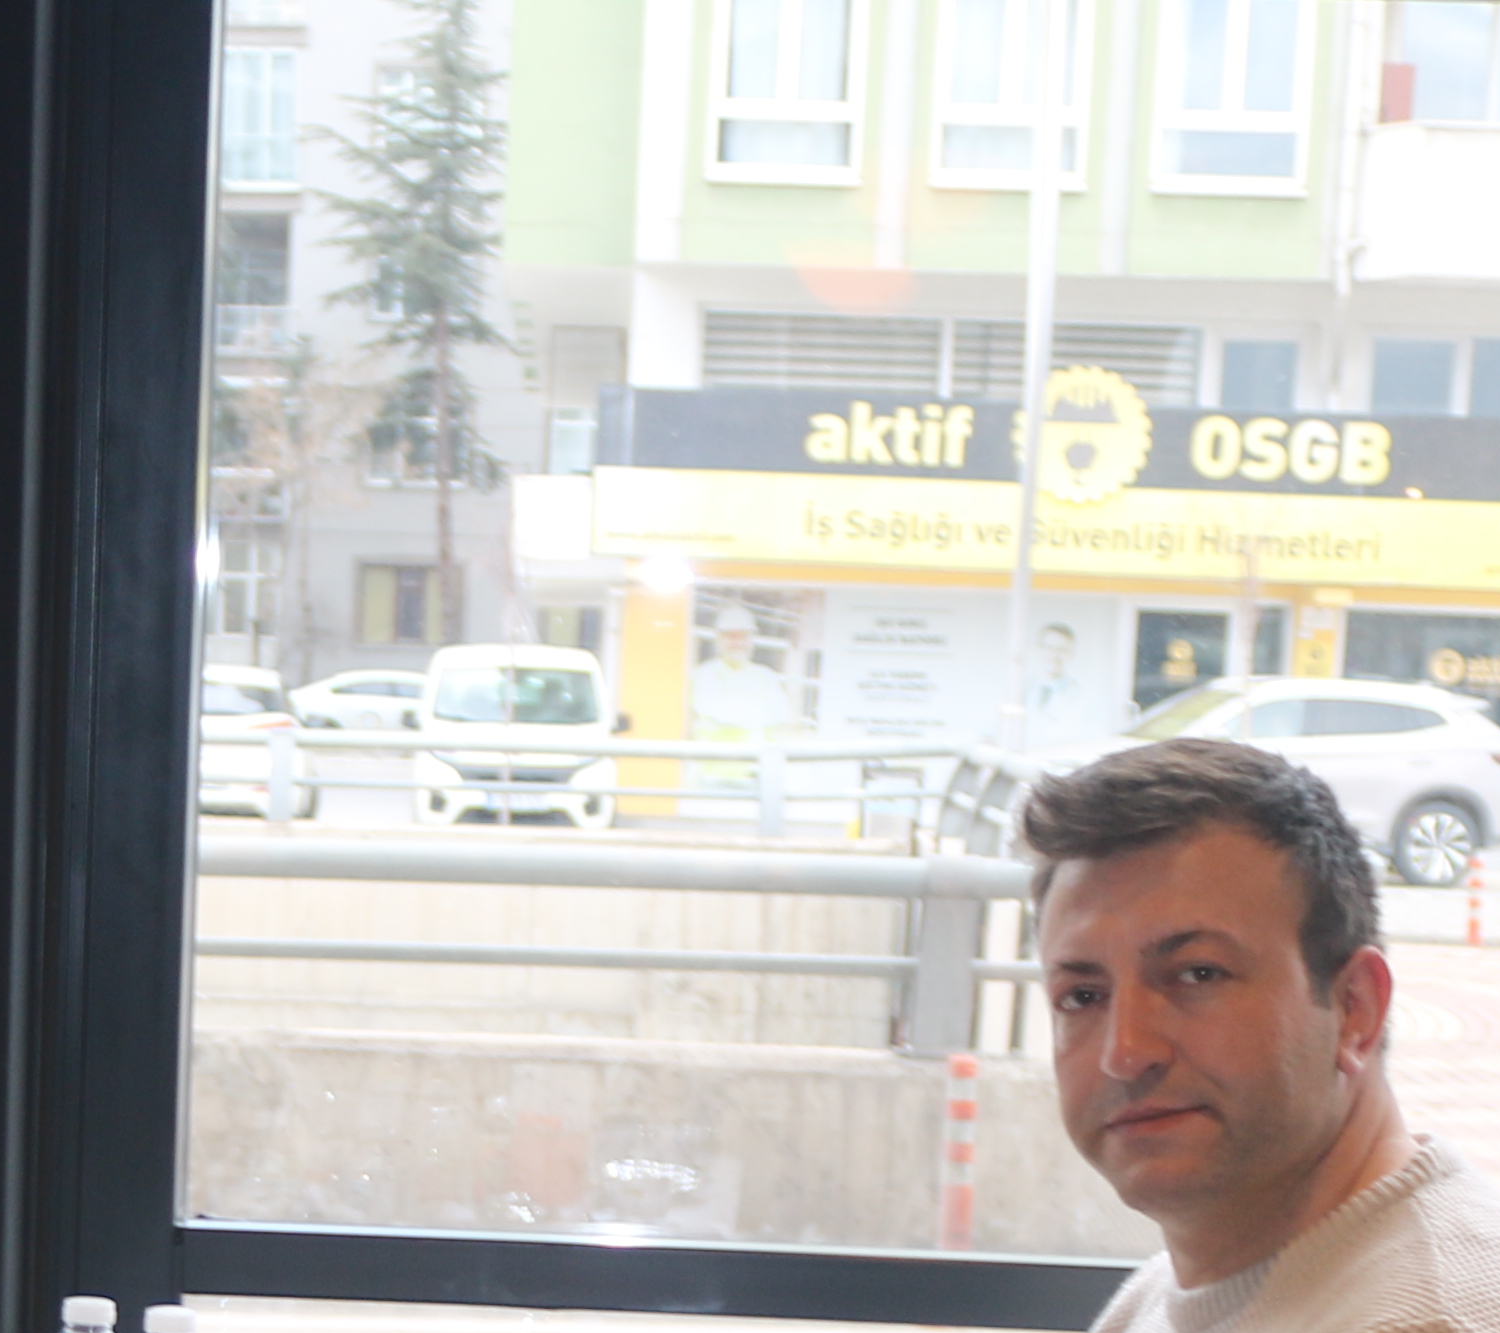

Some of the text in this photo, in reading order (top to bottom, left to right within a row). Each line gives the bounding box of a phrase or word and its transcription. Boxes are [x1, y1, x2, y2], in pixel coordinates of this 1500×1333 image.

[804, 401, 1394, 487] aktif OSGB
[804, 500, 1381, 562] İş Sağlığı ve Güvenliği Hizmetleri
